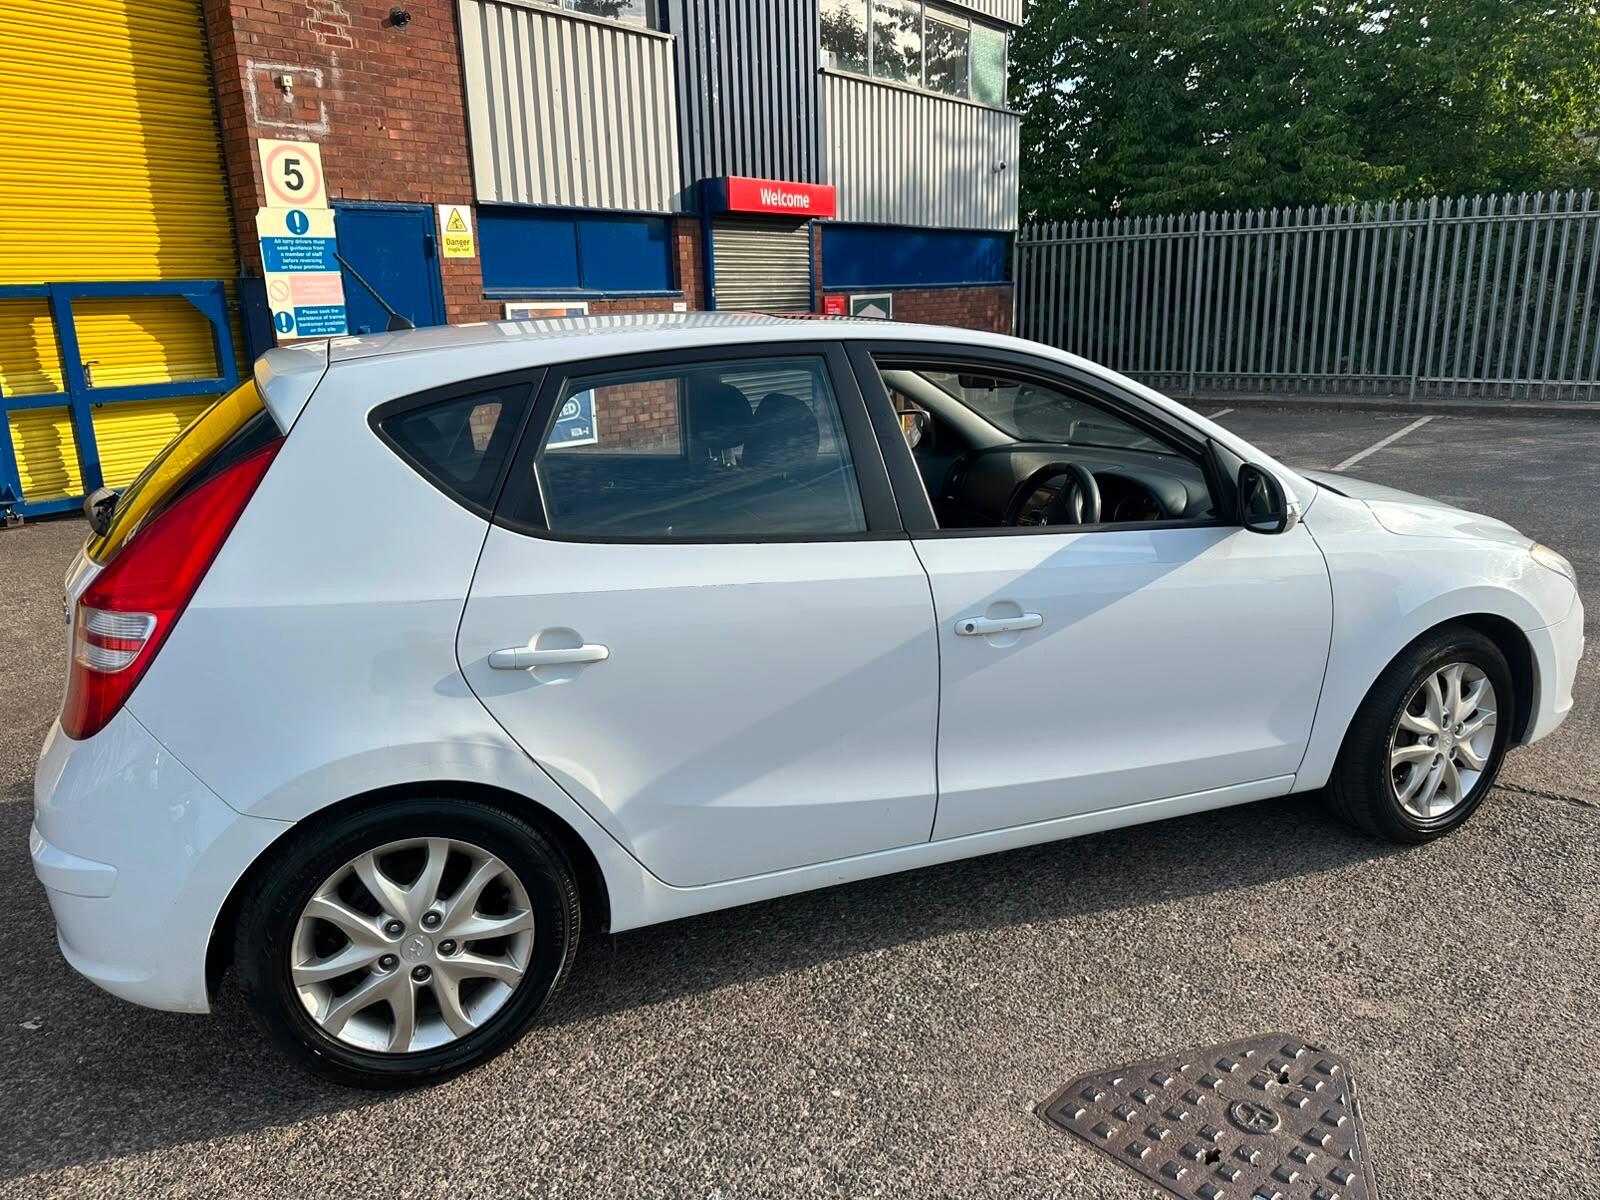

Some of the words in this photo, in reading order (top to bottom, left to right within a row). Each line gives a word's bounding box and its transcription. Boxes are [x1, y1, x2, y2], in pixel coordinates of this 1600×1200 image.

[284, 158, 304, 191] 5
[760, 187, 810, 208] Welcome
[446, 238, 470, 247] Danger
